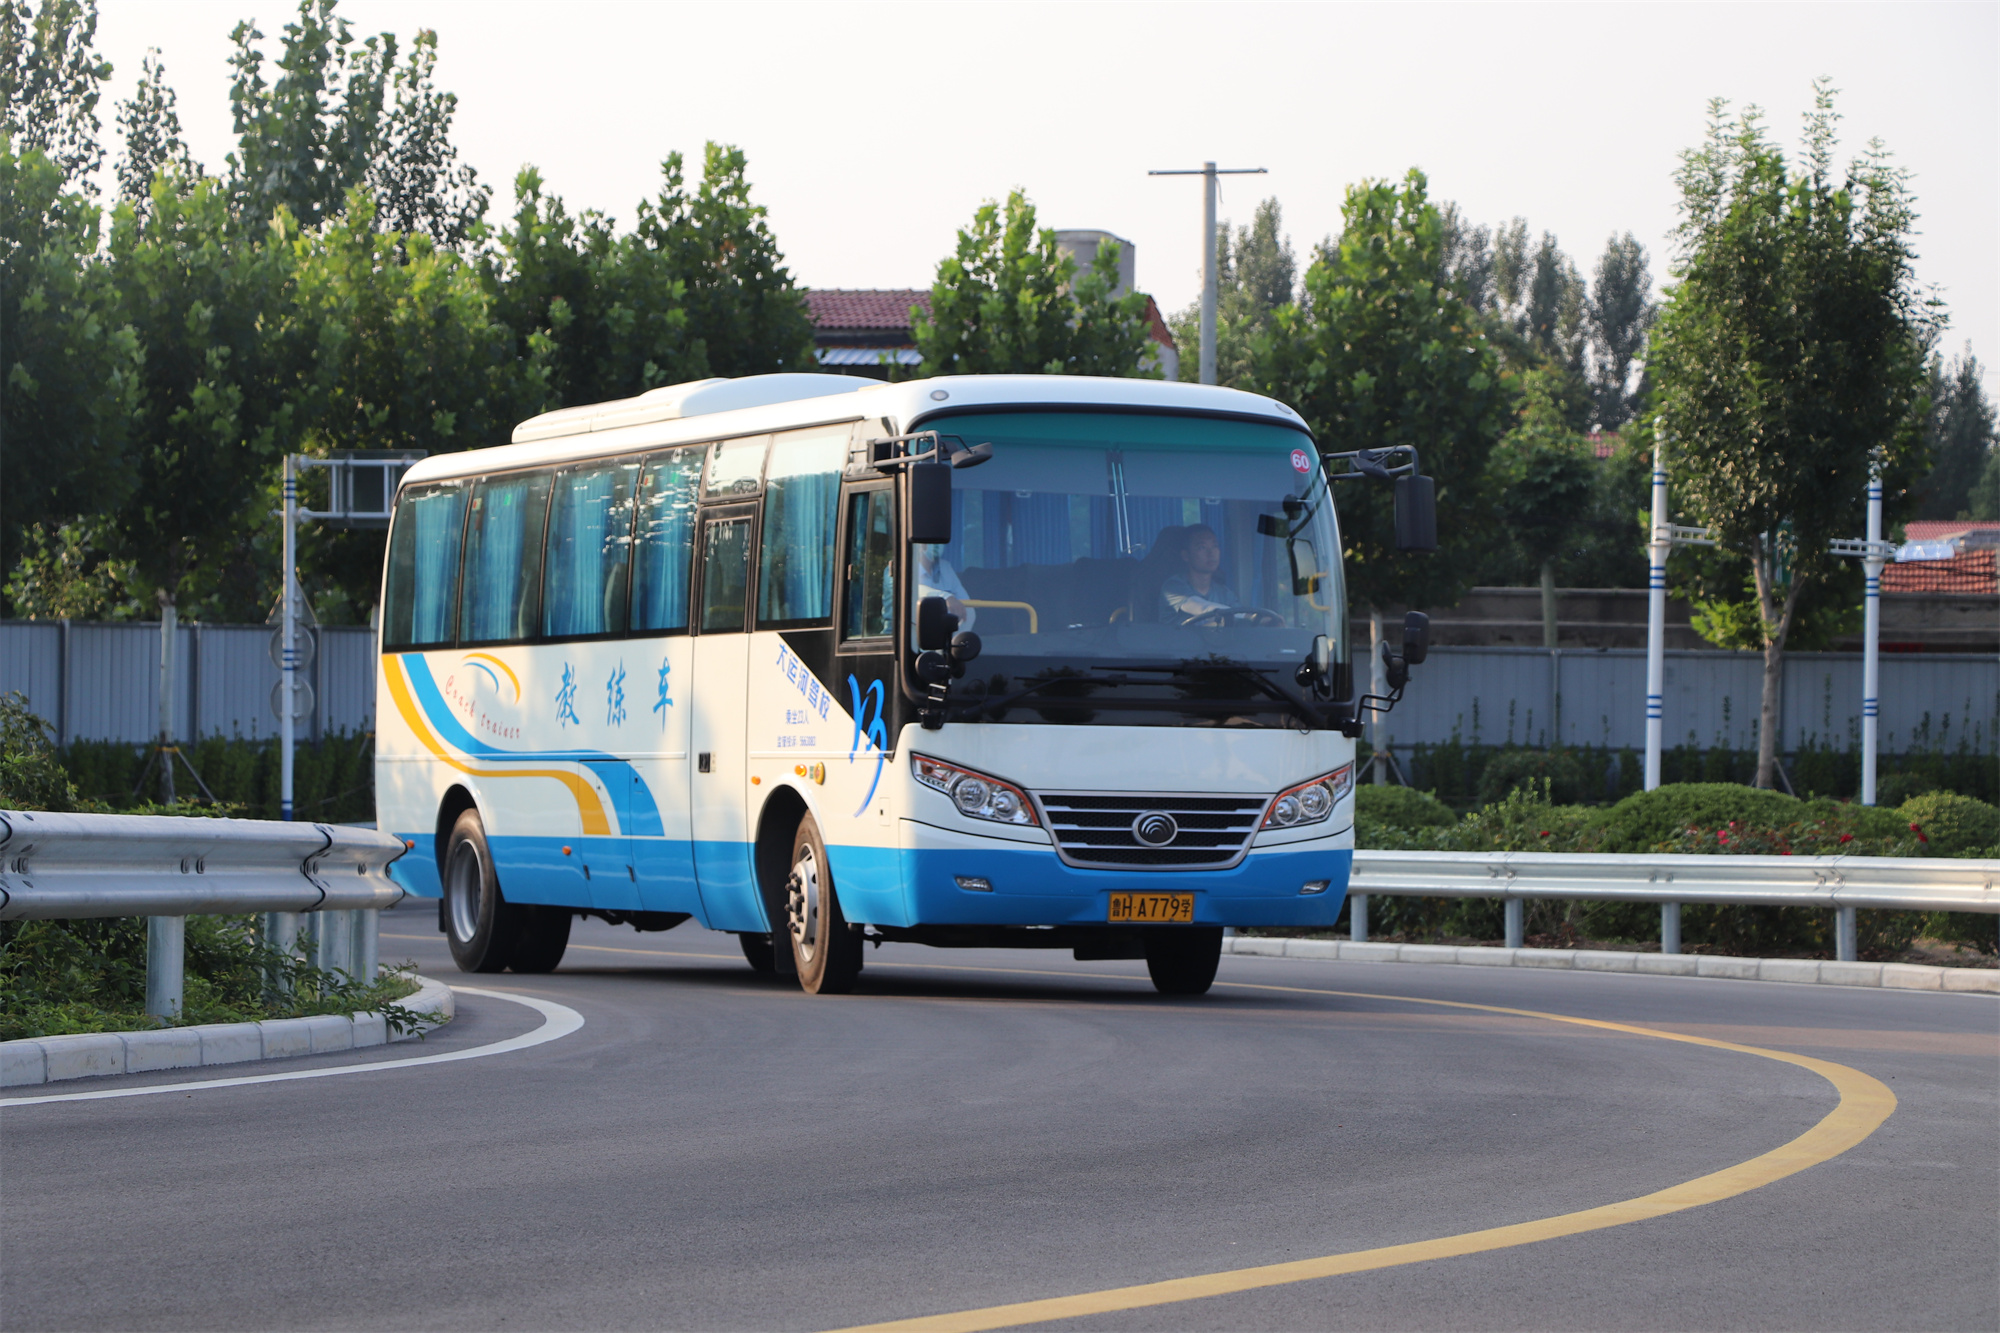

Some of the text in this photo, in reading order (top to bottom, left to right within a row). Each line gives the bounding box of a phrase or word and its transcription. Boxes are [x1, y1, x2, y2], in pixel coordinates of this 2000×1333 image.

[1292, 453, 1310, 470] 60
[555, 656, 674, 734] 教练车
[776, 643, 831, 722] 大运河驾校
[481, 713, 520, 739] trainer
